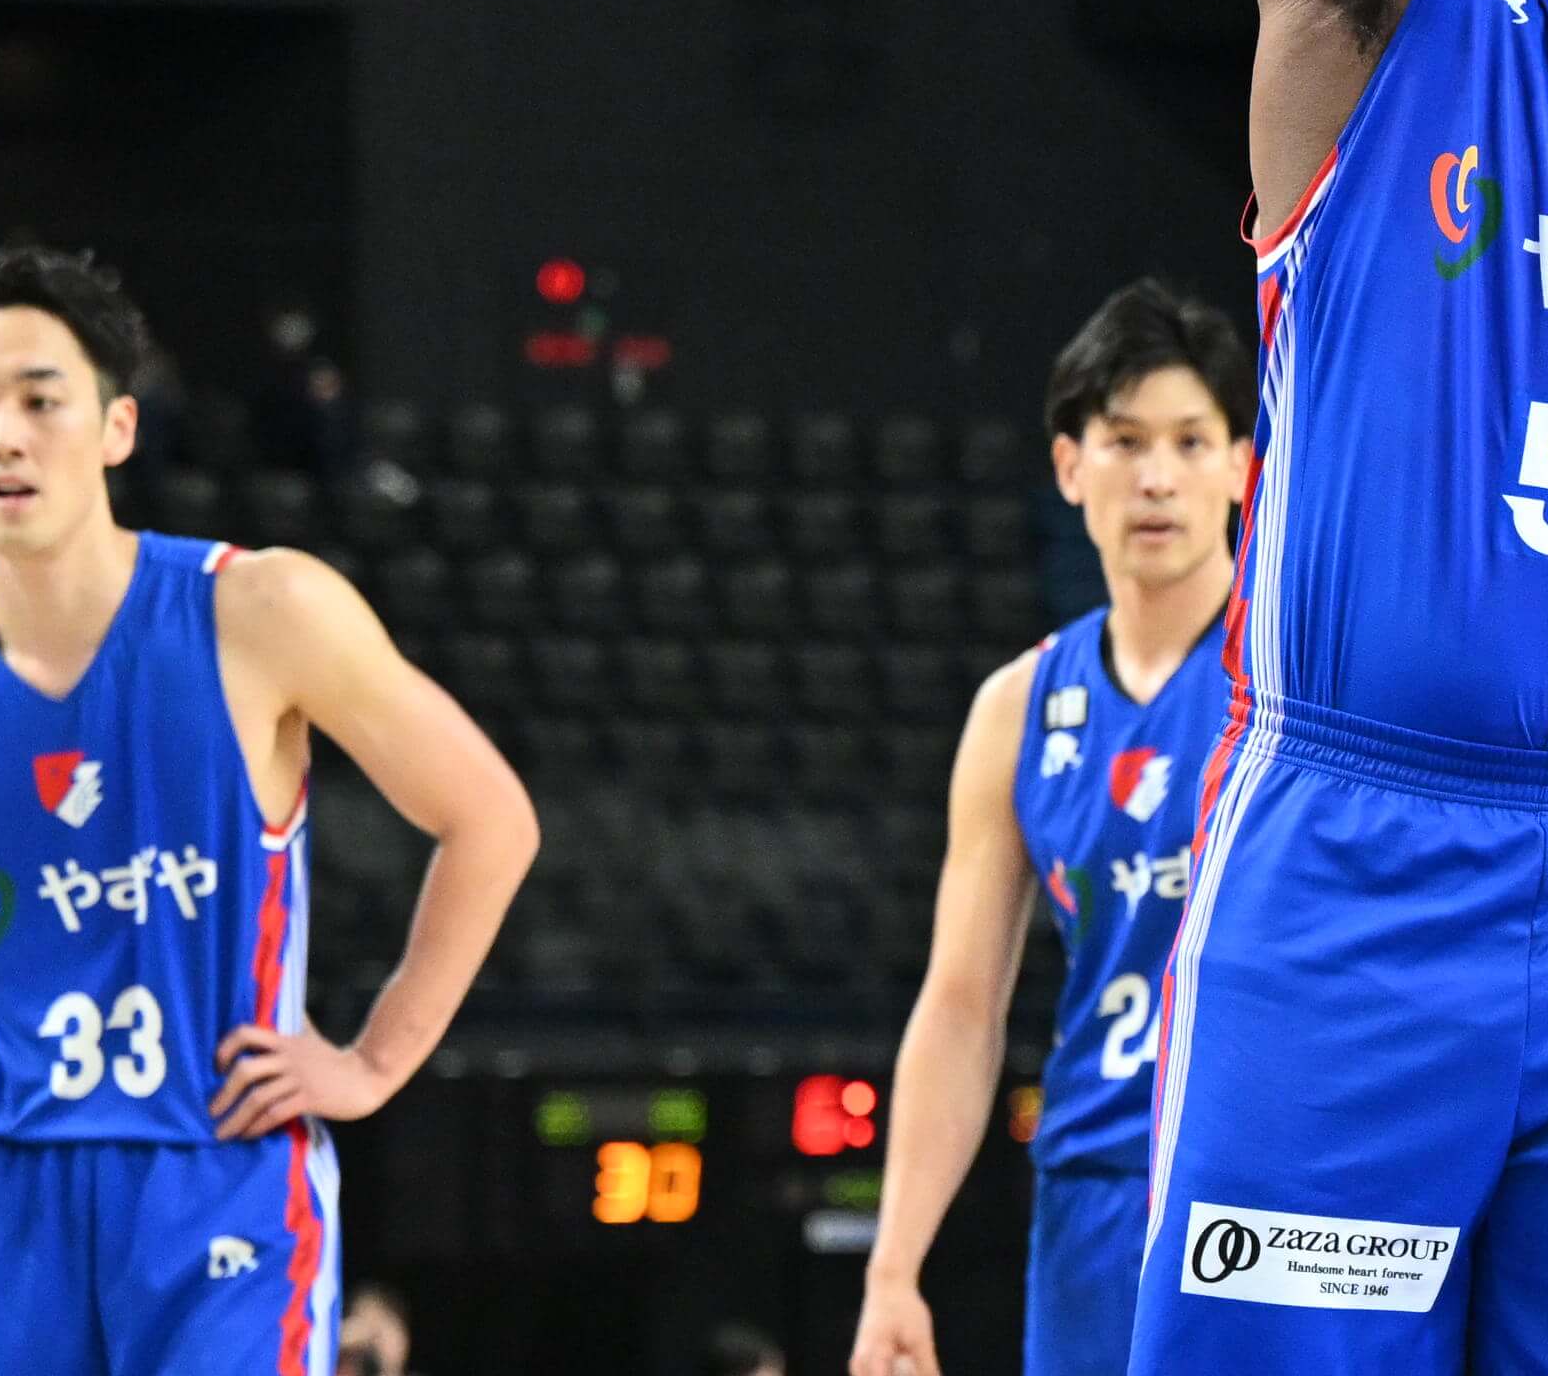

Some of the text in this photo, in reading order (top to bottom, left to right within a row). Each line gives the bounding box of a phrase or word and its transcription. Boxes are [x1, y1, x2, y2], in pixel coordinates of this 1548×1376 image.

[38, 843, 218, 933] やずや
[38, 985, 167, 1100] 33
[1345, 1233, 1450, 1262] GROUP
[1287, 1260, 1424, 1281] Handsome heart forever
[1319, 1281, 1389, 1297] SINCE 1946
